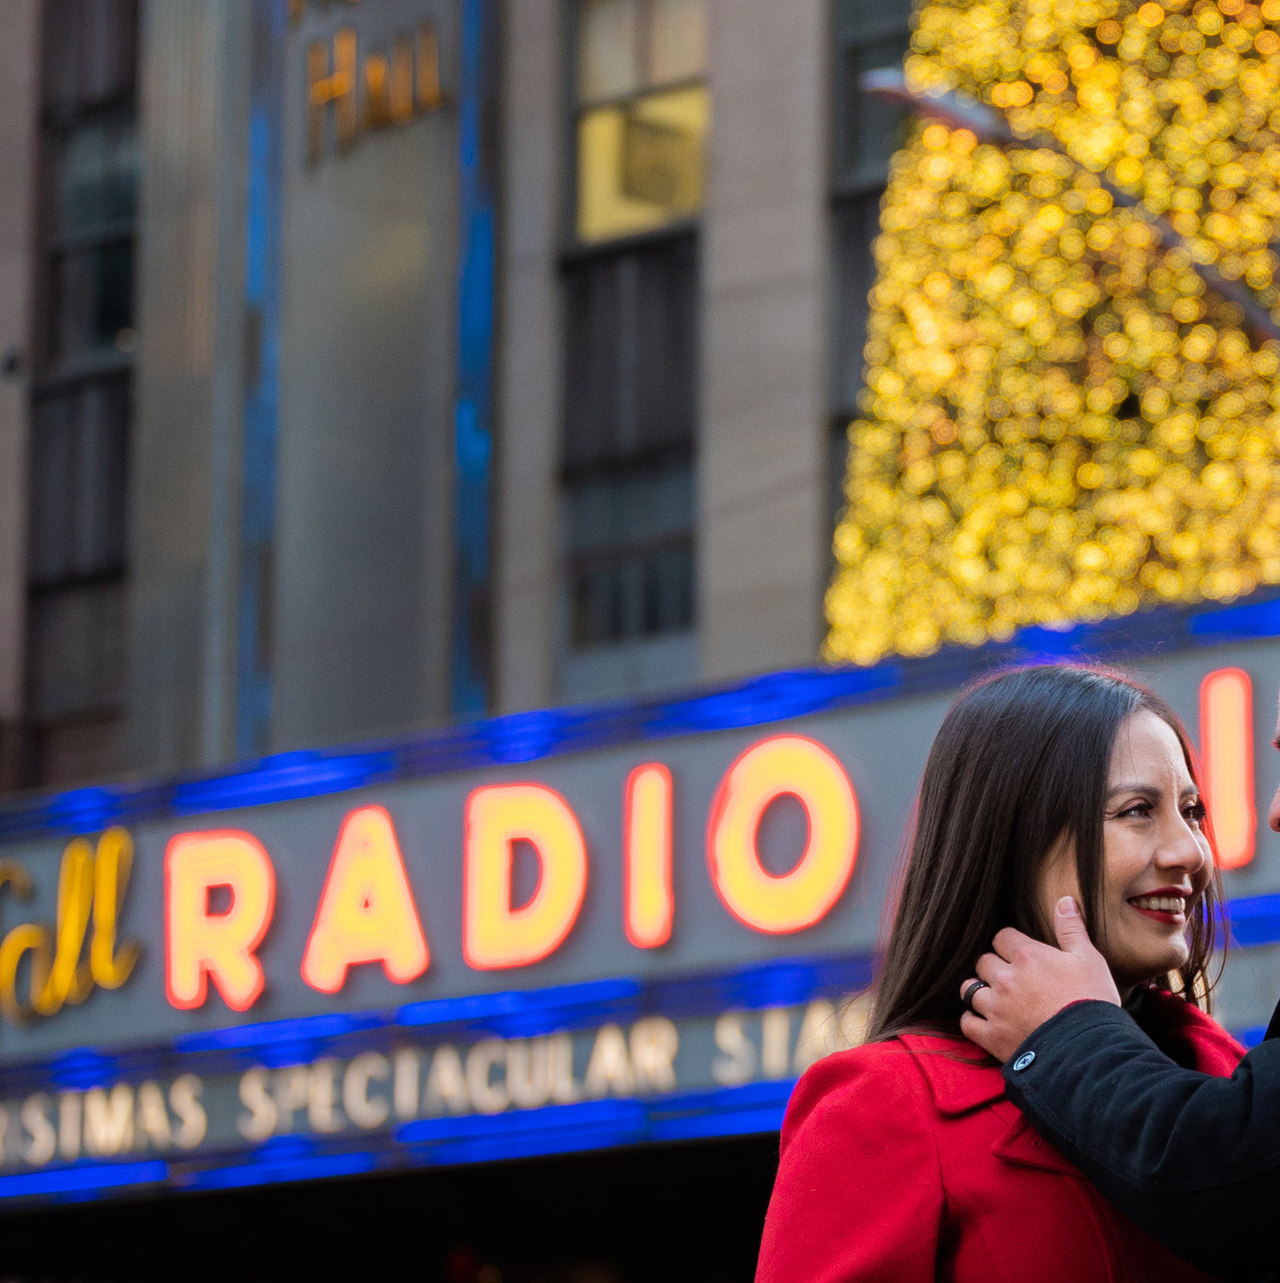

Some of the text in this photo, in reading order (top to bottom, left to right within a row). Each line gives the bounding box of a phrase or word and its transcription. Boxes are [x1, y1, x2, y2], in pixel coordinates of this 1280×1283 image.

[0, 824, 143, 1028] all
[163, 732, 861, 1012] RADIO
[236, 1015, 680, 1145] SPECTACULAR
